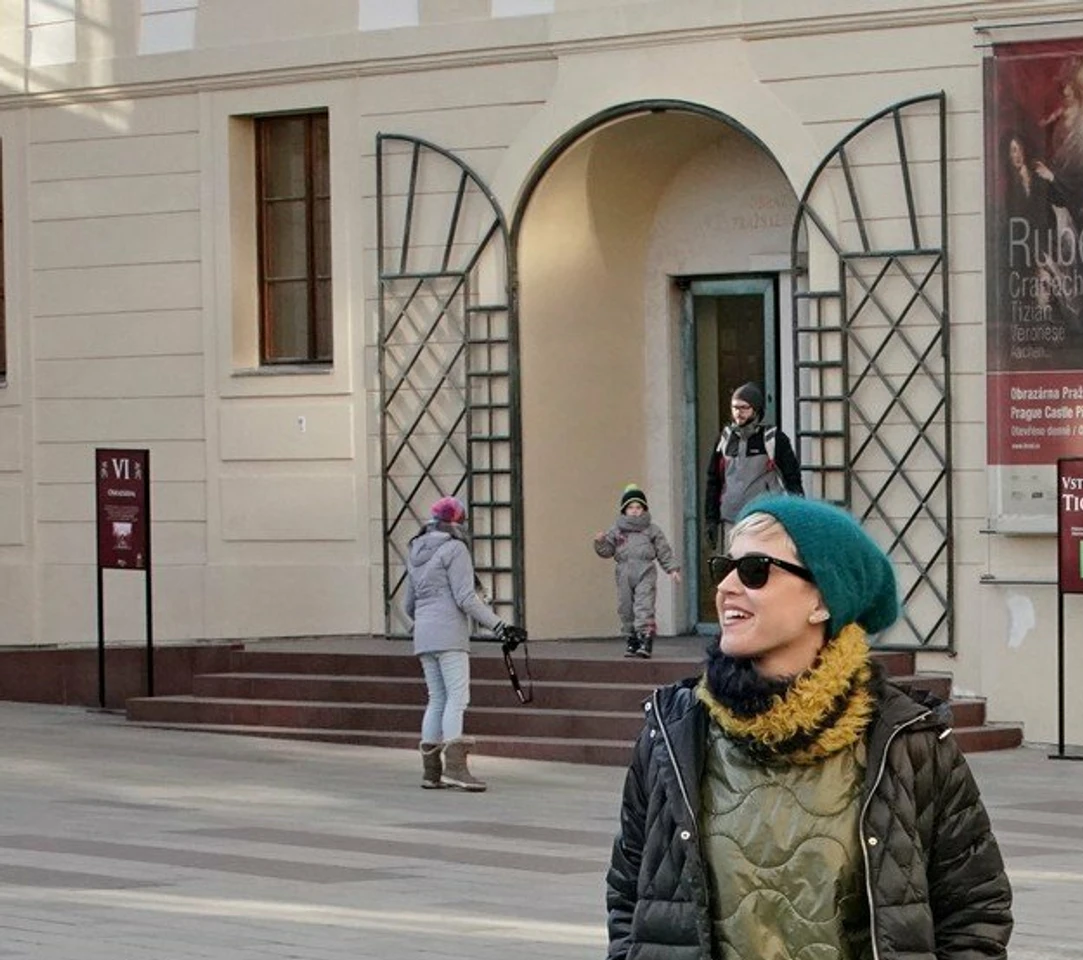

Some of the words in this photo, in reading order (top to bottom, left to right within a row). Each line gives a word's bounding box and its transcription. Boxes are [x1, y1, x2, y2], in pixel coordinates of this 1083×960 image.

[1010, 406, 1043, 422] Prague
[1044, 405, 1074, 419] Castle
[111, 458, 130, 480] VI
